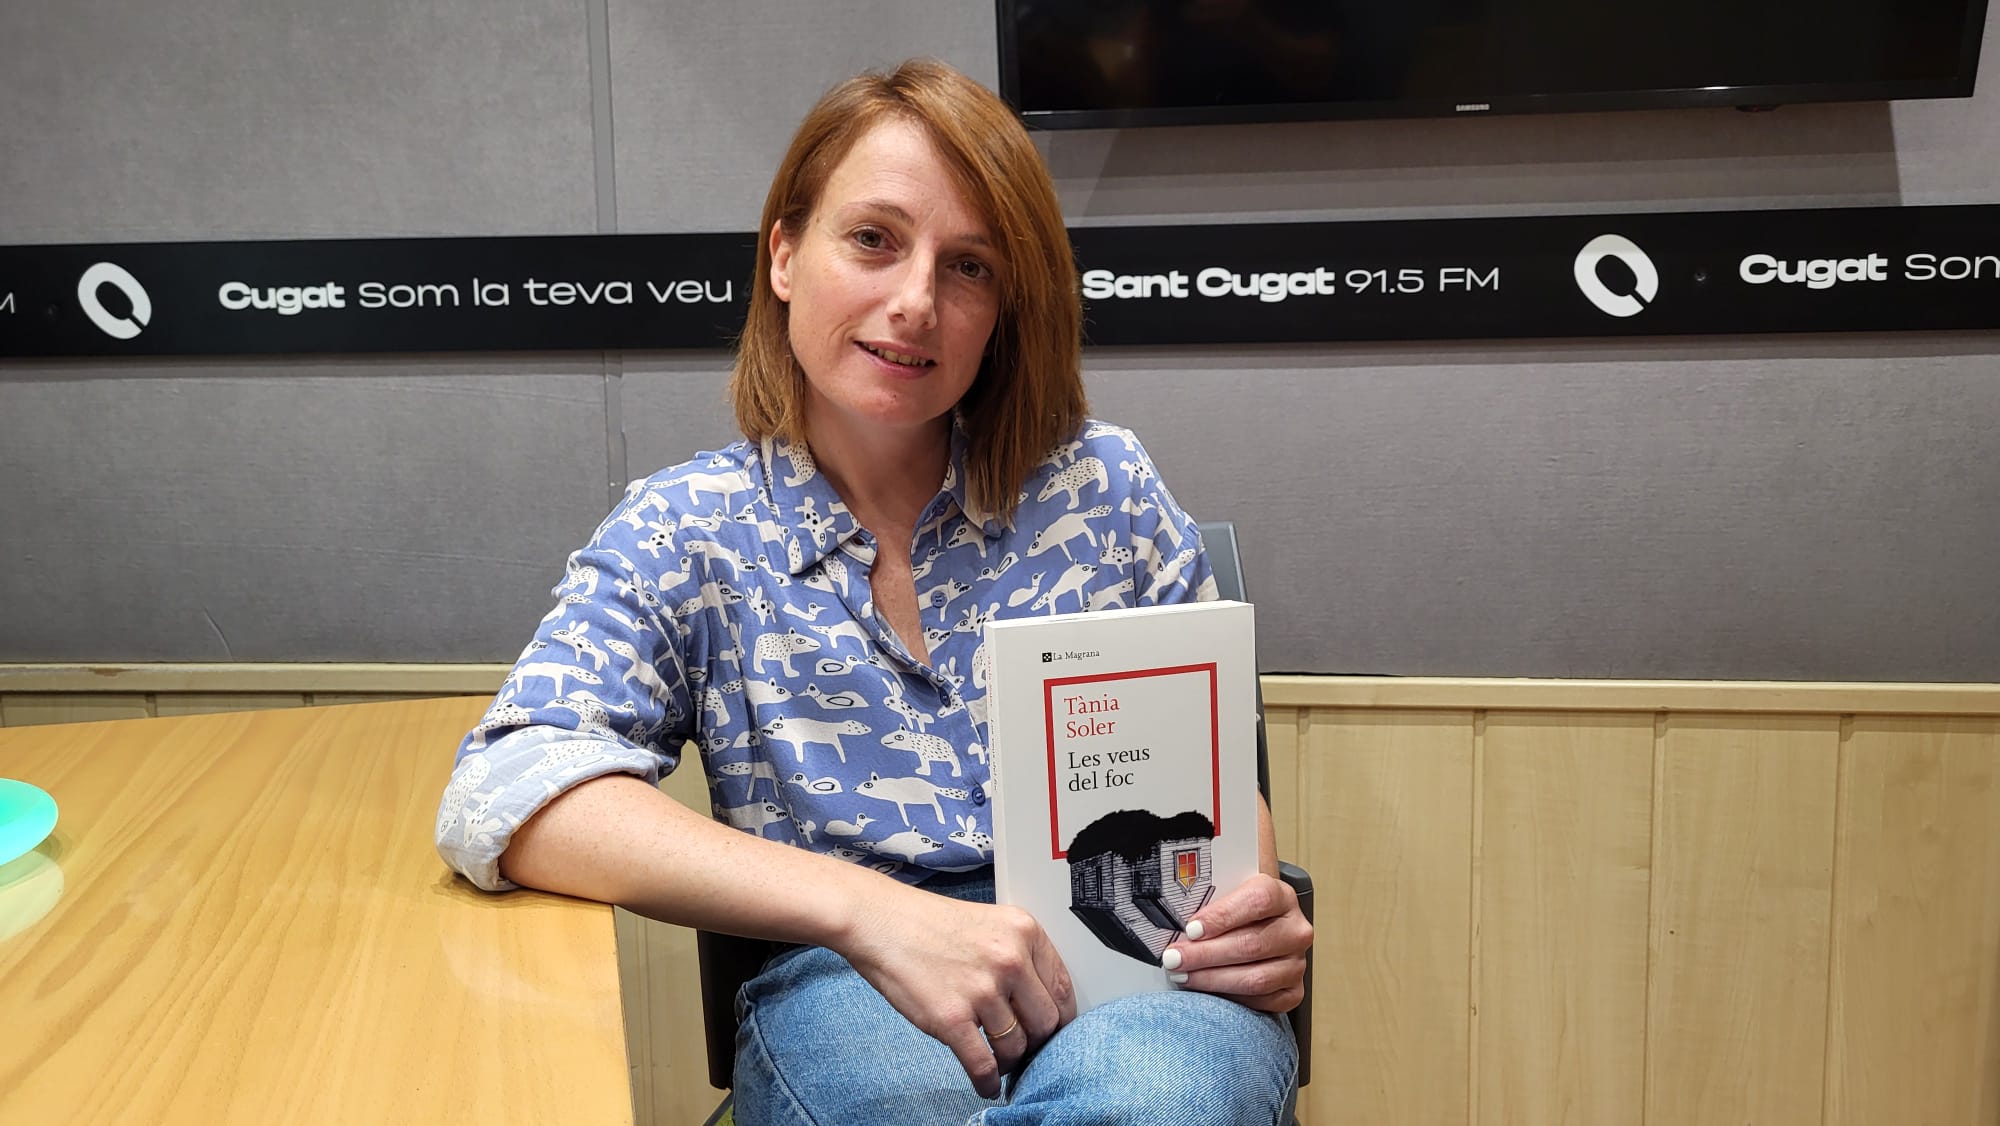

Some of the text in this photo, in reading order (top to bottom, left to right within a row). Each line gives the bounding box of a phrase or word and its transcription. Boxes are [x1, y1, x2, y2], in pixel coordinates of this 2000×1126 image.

[1739, 252, 1889, 290] Cugat
[1082, 266, 1499, 303] Sant Cugat 91.5 FM
[218, 277, 733, 316] Cugat Som la teva veu
[1053, 650, 1100, 661] La Magrana
[1063, 693, 1121, 716] Tània
[1066, 717, 1116, 739] Soler
[1067, 748, 1151, 770] Les veus
[1068, 769, 1134, 792] del foc
